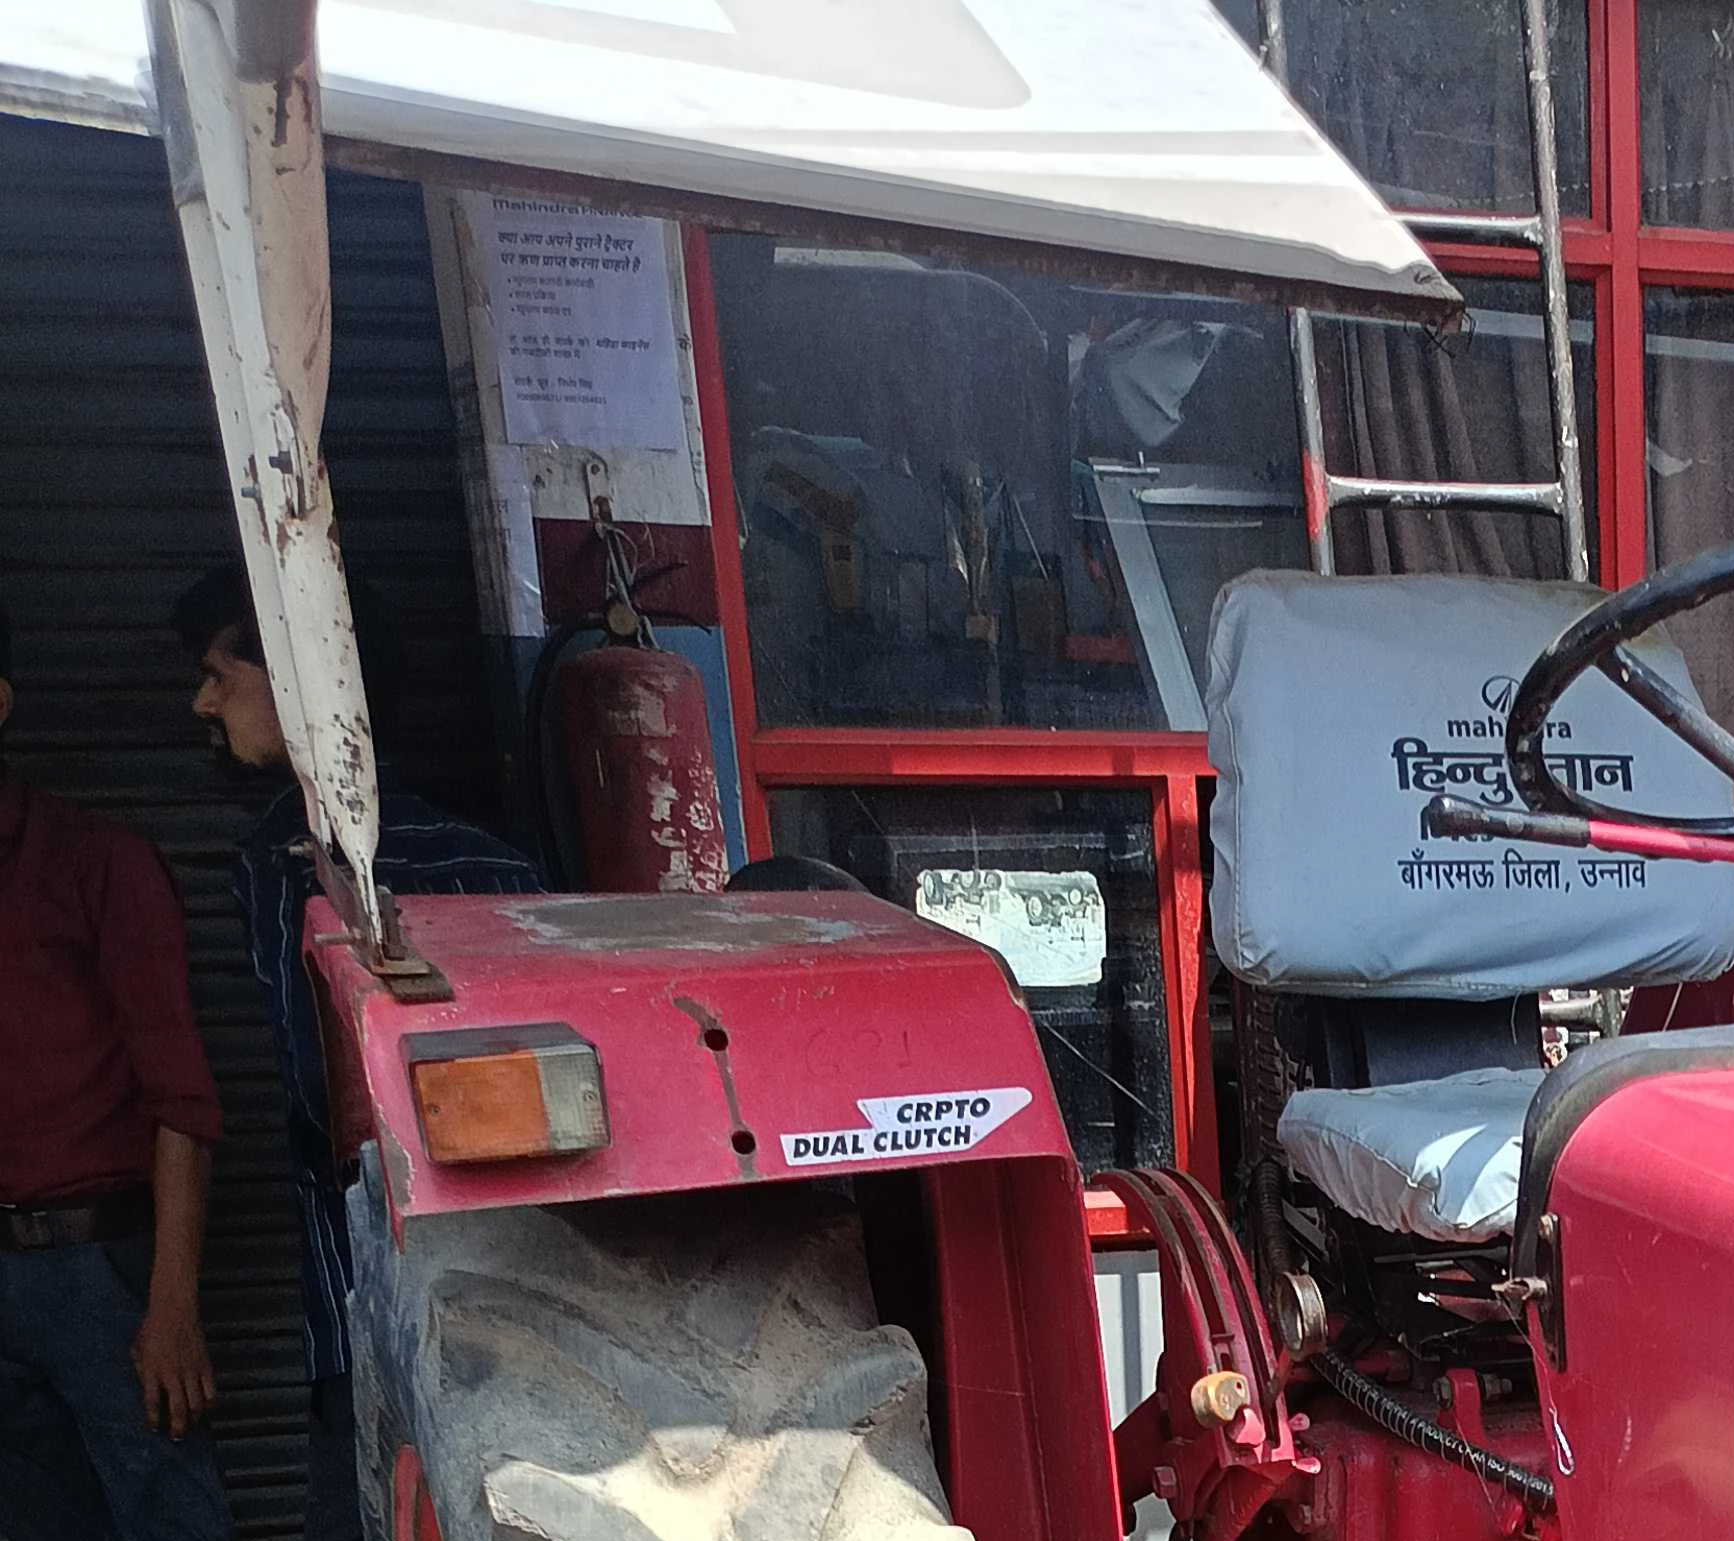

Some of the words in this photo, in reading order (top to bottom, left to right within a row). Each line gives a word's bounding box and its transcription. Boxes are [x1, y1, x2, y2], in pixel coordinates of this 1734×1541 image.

[1447, 716, 1572, 739] mahra
[1398, 848, 1494, 890] बाँगरमऊ
[1578, 859, 1646, 888] उन्नाव
[897, 1097, 991, 1123] CRPTO
[793, 1134, 864, 1158] DUAL
[873, 1125, 971, 1151] CLUTCH
